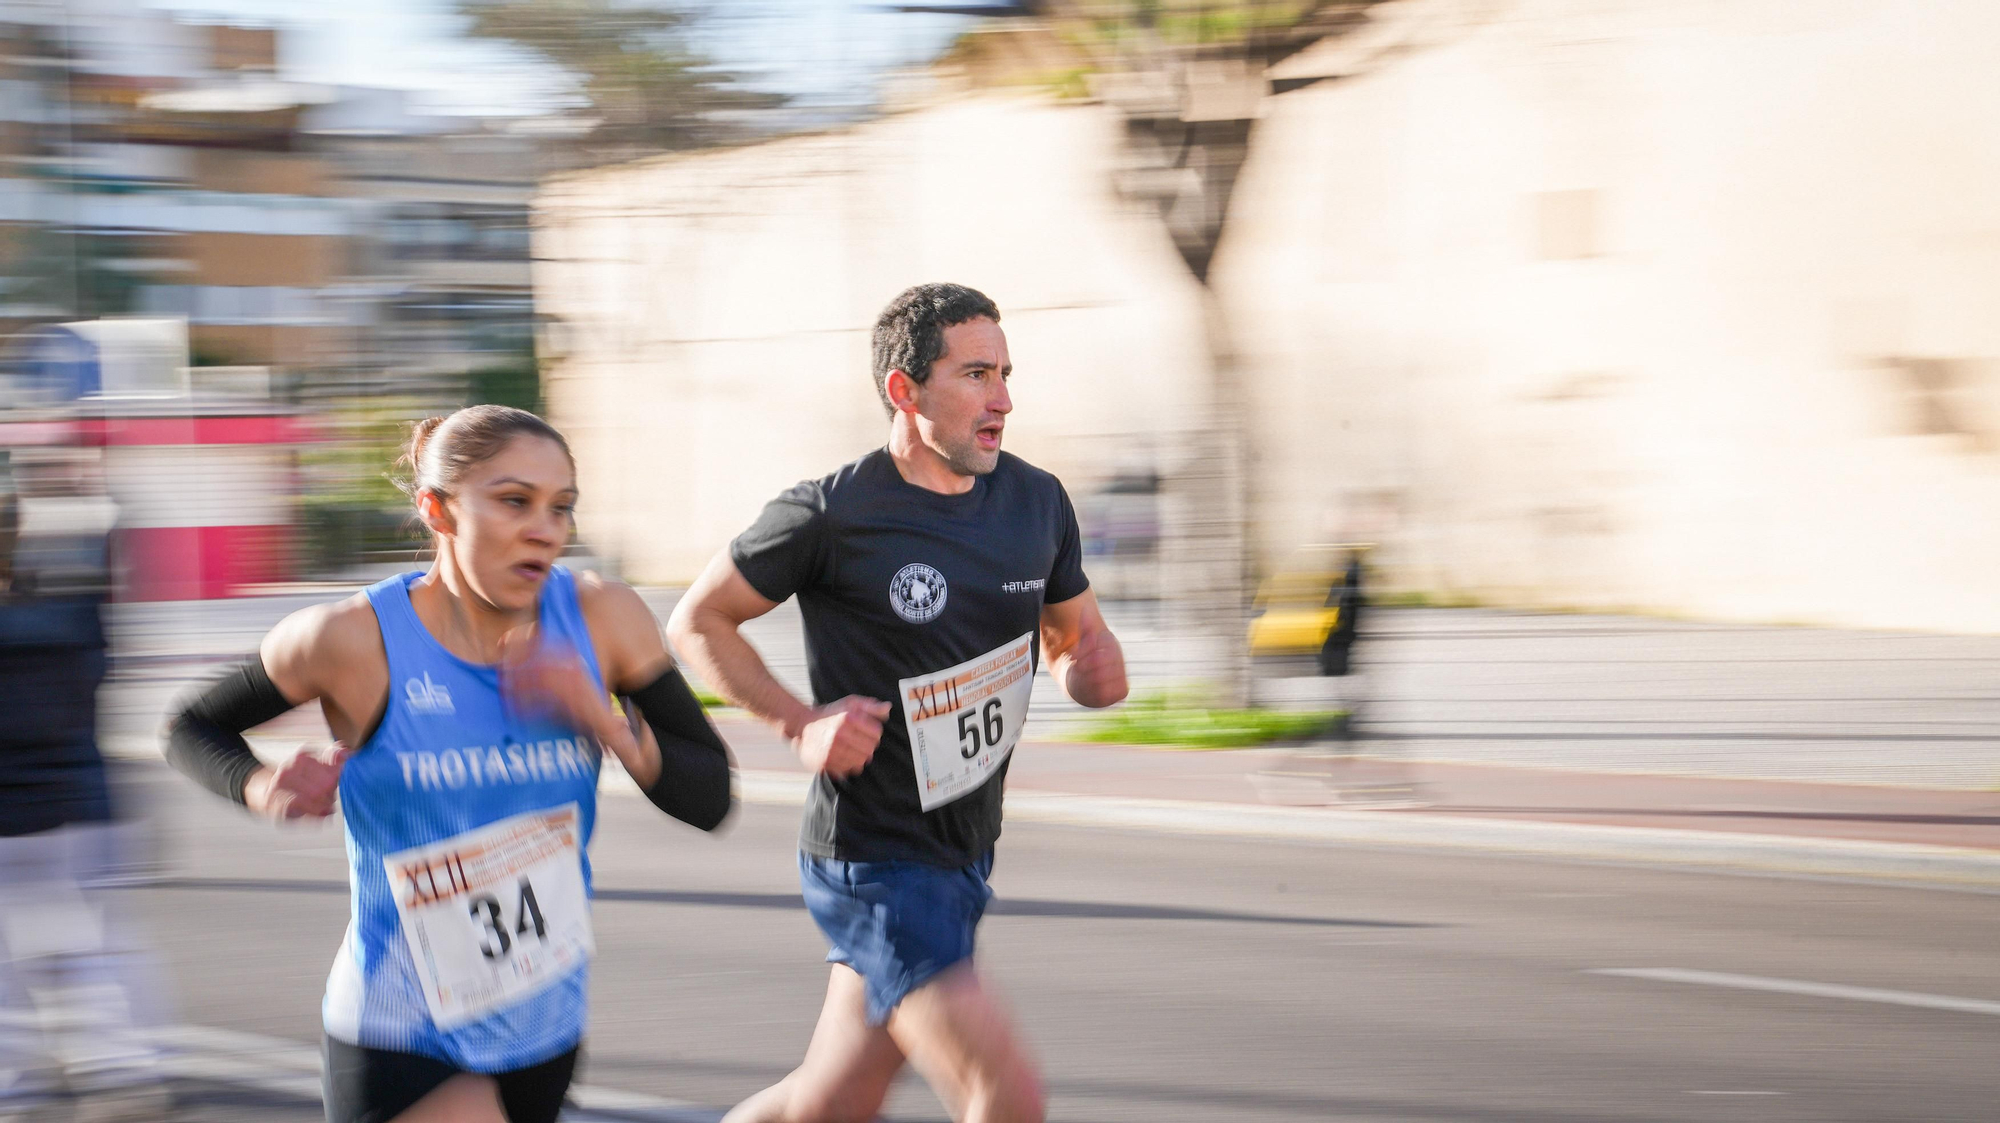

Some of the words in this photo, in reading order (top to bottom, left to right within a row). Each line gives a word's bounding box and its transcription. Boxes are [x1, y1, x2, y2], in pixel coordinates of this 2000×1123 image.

[911, 677, 960, 722] XLII
[957, 696, 1003, 759] 56
[401, 849, 470, 910] XLII
[469, 877, 547, 960] 34
